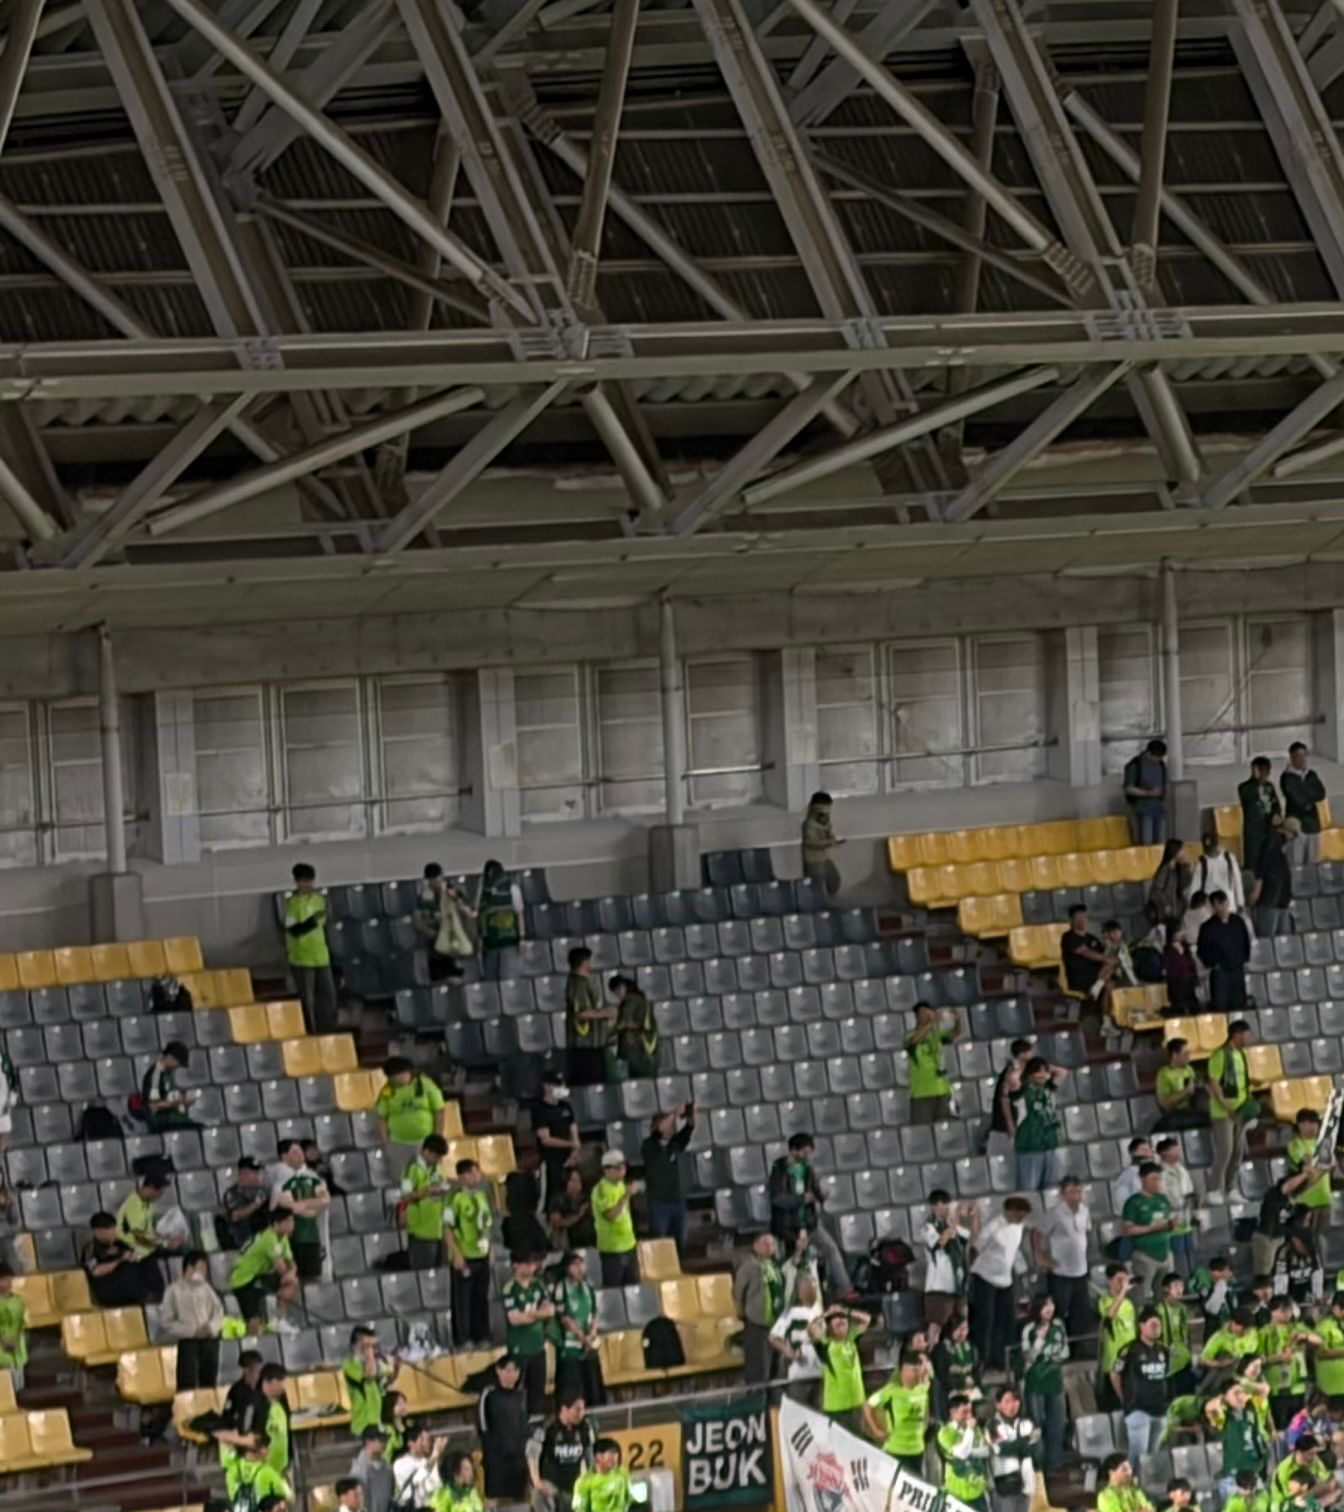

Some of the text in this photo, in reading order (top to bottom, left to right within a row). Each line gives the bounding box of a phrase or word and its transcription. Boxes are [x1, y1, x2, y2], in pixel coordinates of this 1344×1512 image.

[686, 1411, 767, 1454] JEON
[628, 1440, 665, 1471] 22
[688, 1448, 767, 1495] BUK
